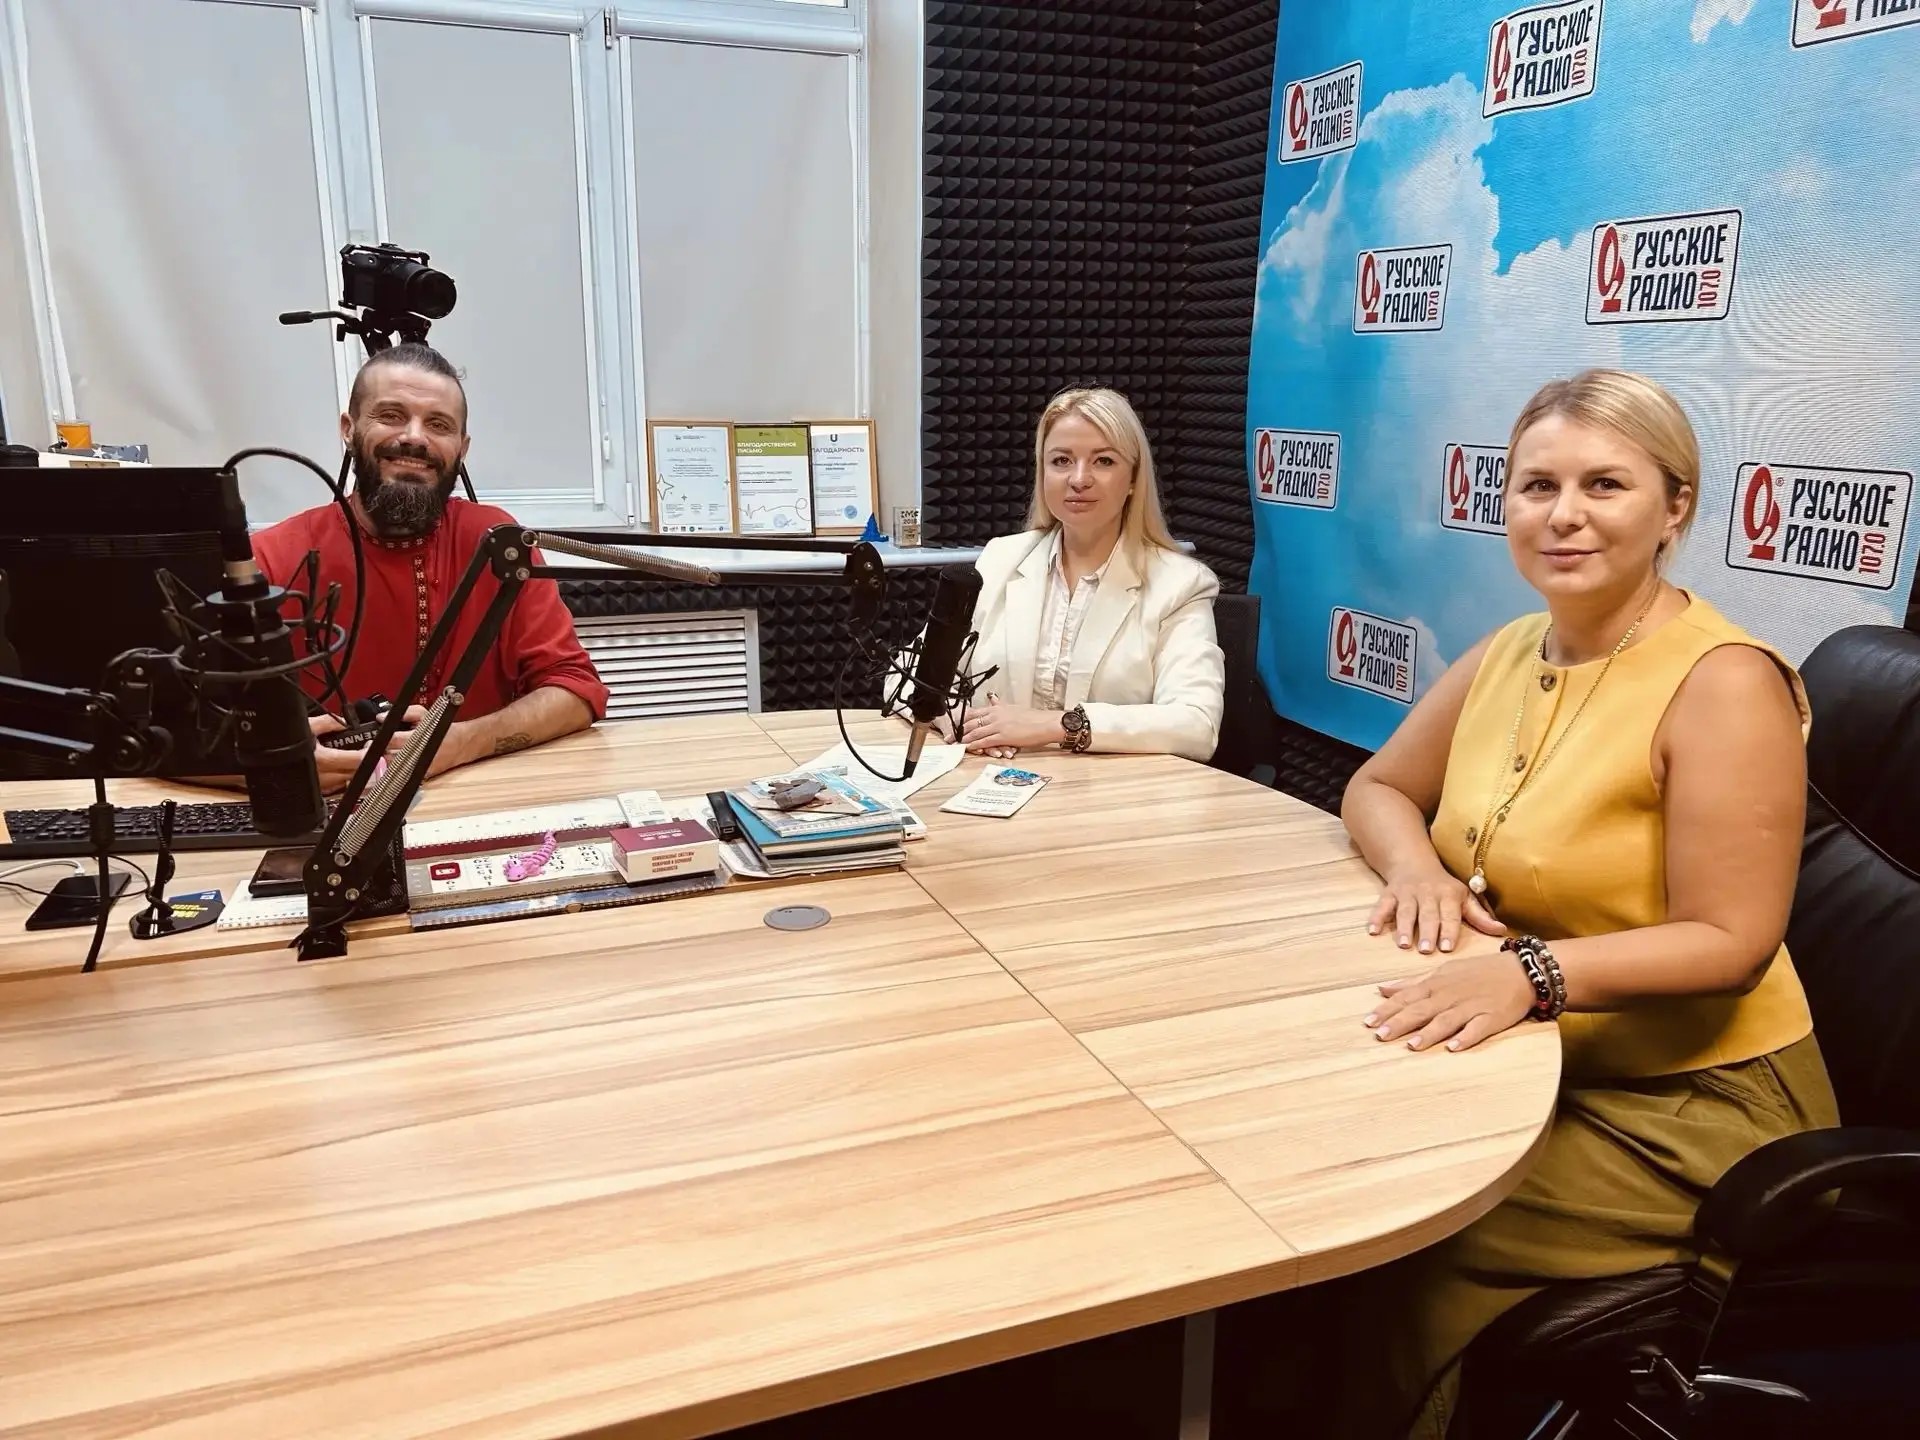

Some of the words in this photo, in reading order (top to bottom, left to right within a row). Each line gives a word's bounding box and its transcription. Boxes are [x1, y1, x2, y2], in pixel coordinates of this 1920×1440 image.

[1516, 5, 1594, 58] РУССКОЕ
[1511, 53, 1572, 99] РАДИО
[1571, 48, 1588, 88] 107.0
[1312, 74, 1355, 116] РУССКОЕ
[1309, 113, 1343, 149] РАДИО
[1343, 110, 1353, 140] 107.0
[1632, 224, 1728, 270] РУССКОЕ
[1385, 254, 1445, 289] РУССКОЕ
[1697, 269, 1721, 309] 107.0
[1382, 291, 1428, 323] РАДИО
[1427, 290, 1440, 321] 107.0
[1627, 270, 1697, 312] РАДИО
[1279, 439, 1334, 470] РУССКОЕ
[1276, 469, 1317, 499] РАДИО
[1317, 473, 1331, 500] 107.0
[1789, 478, 1896, 528] РУССКОЕ
[1472, 491, 1505, 526] РАД
[1782, 524, 1859, 572] РАДИО
[1858, 532, 1886, 574] 107.0
[1361, 622, 1410, 663] РУССКОЕ
[1358, 653, 1395, 690] РАДИО
[1396, 664, 1408, 693] 107.0
